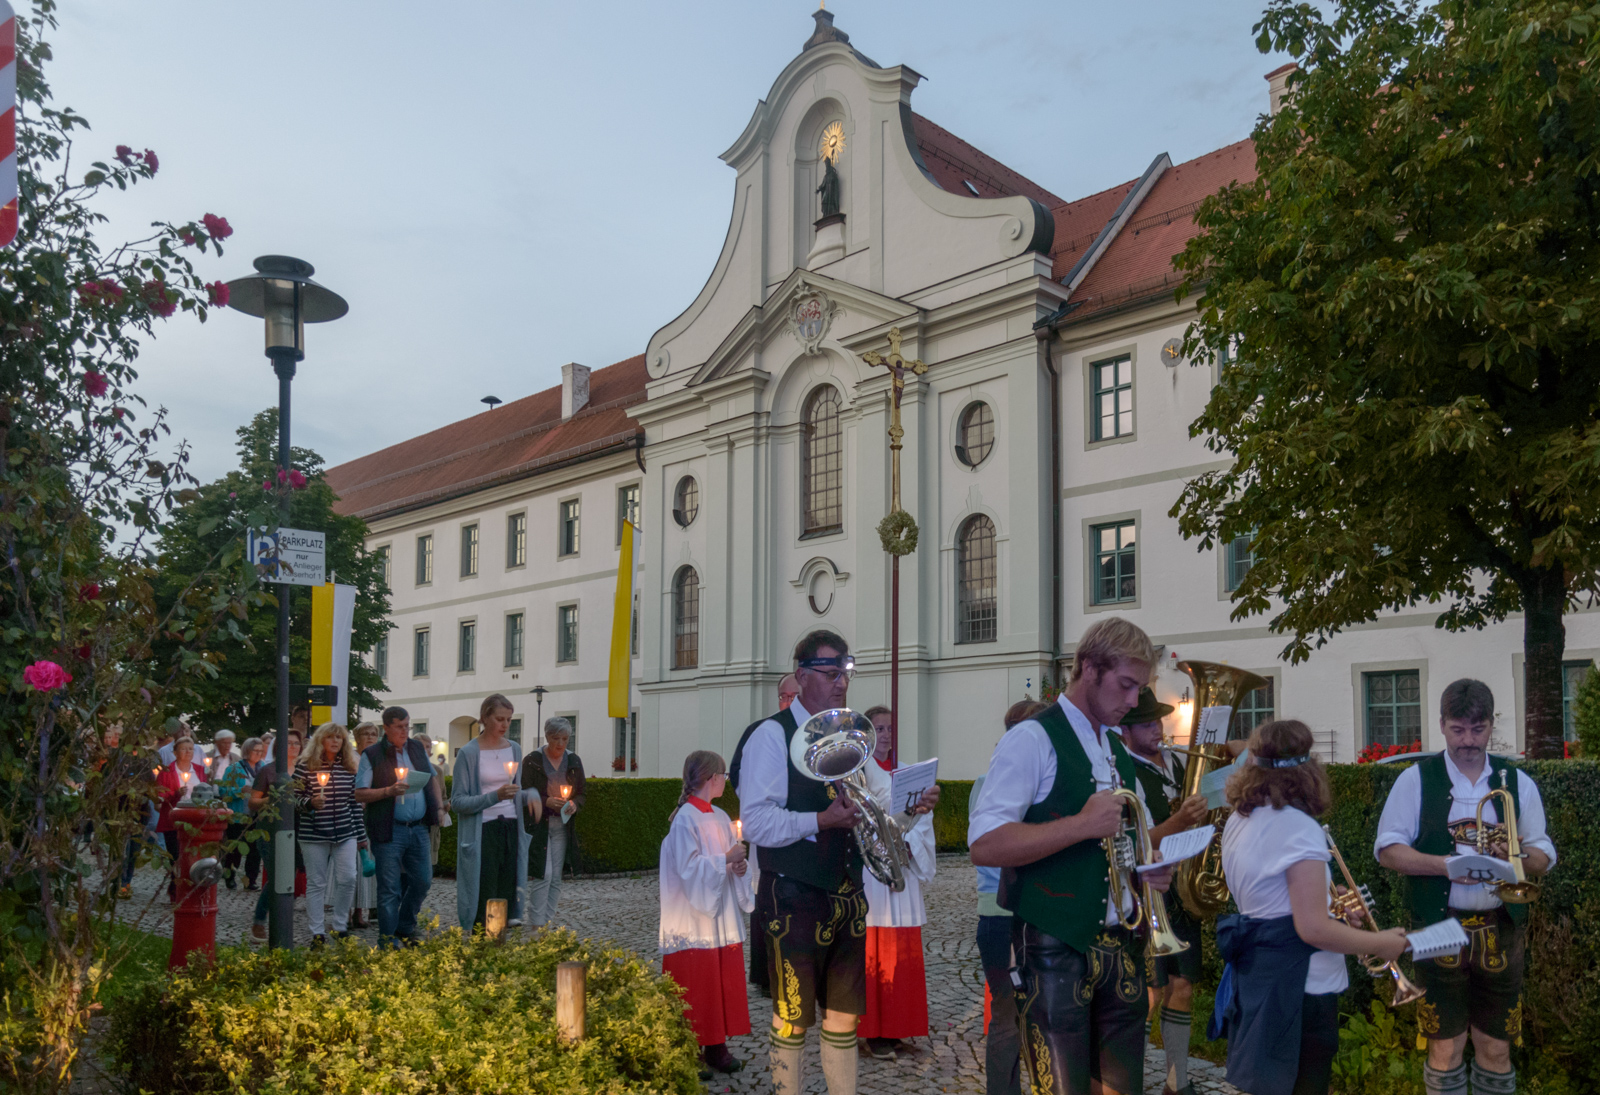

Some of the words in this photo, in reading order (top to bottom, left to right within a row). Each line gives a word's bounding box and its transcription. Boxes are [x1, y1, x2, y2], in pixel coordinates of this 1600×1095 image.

[282, 536, 323, 548] PARKPLATZ
[254, 536, 276, 566] P
[294, 562, 322, 571] Anlieger
